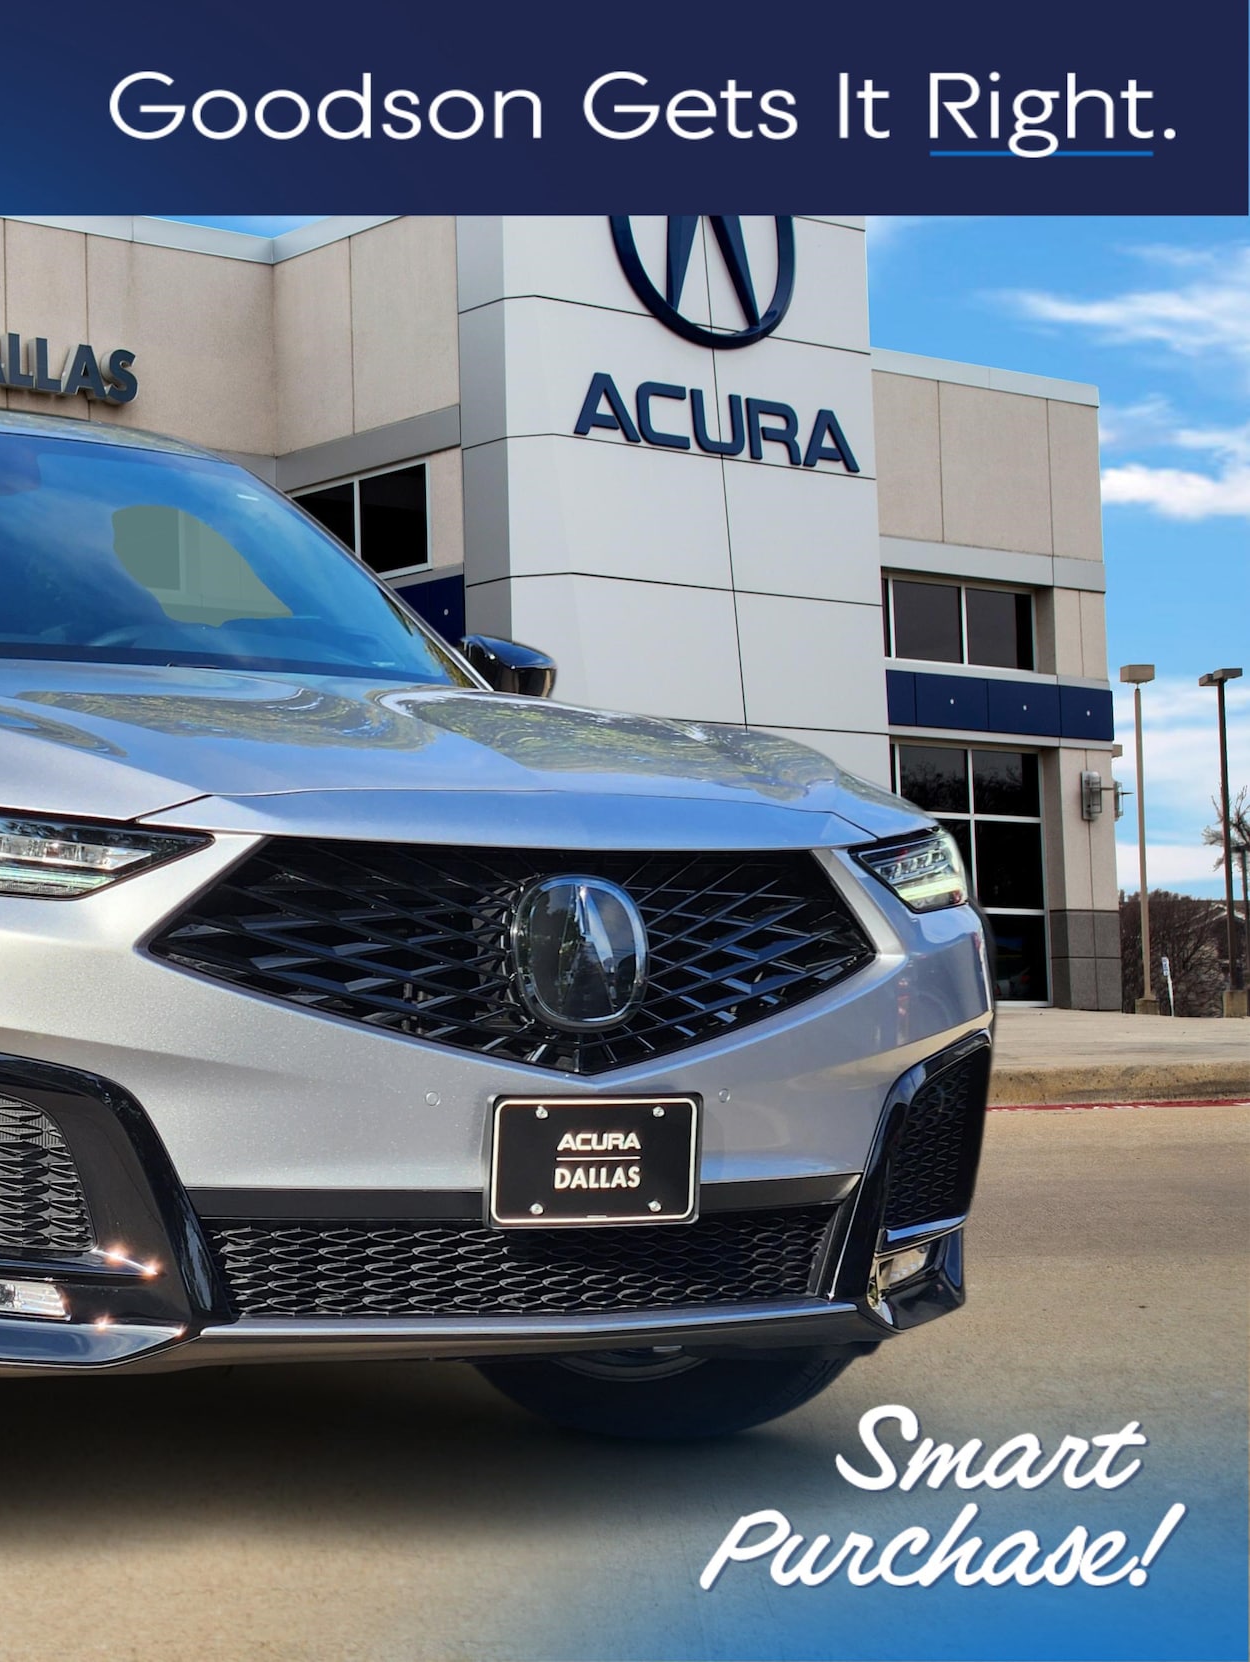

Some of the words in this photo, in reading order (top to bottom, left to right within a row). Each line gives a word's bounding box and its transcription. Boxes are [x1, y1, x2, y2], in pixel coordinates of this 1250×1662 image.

[573, 372, 860, 473] ACURA
[556, 1132, 642, 1151] ACURA
[554, 1165, 641, 1189] DALLAS
